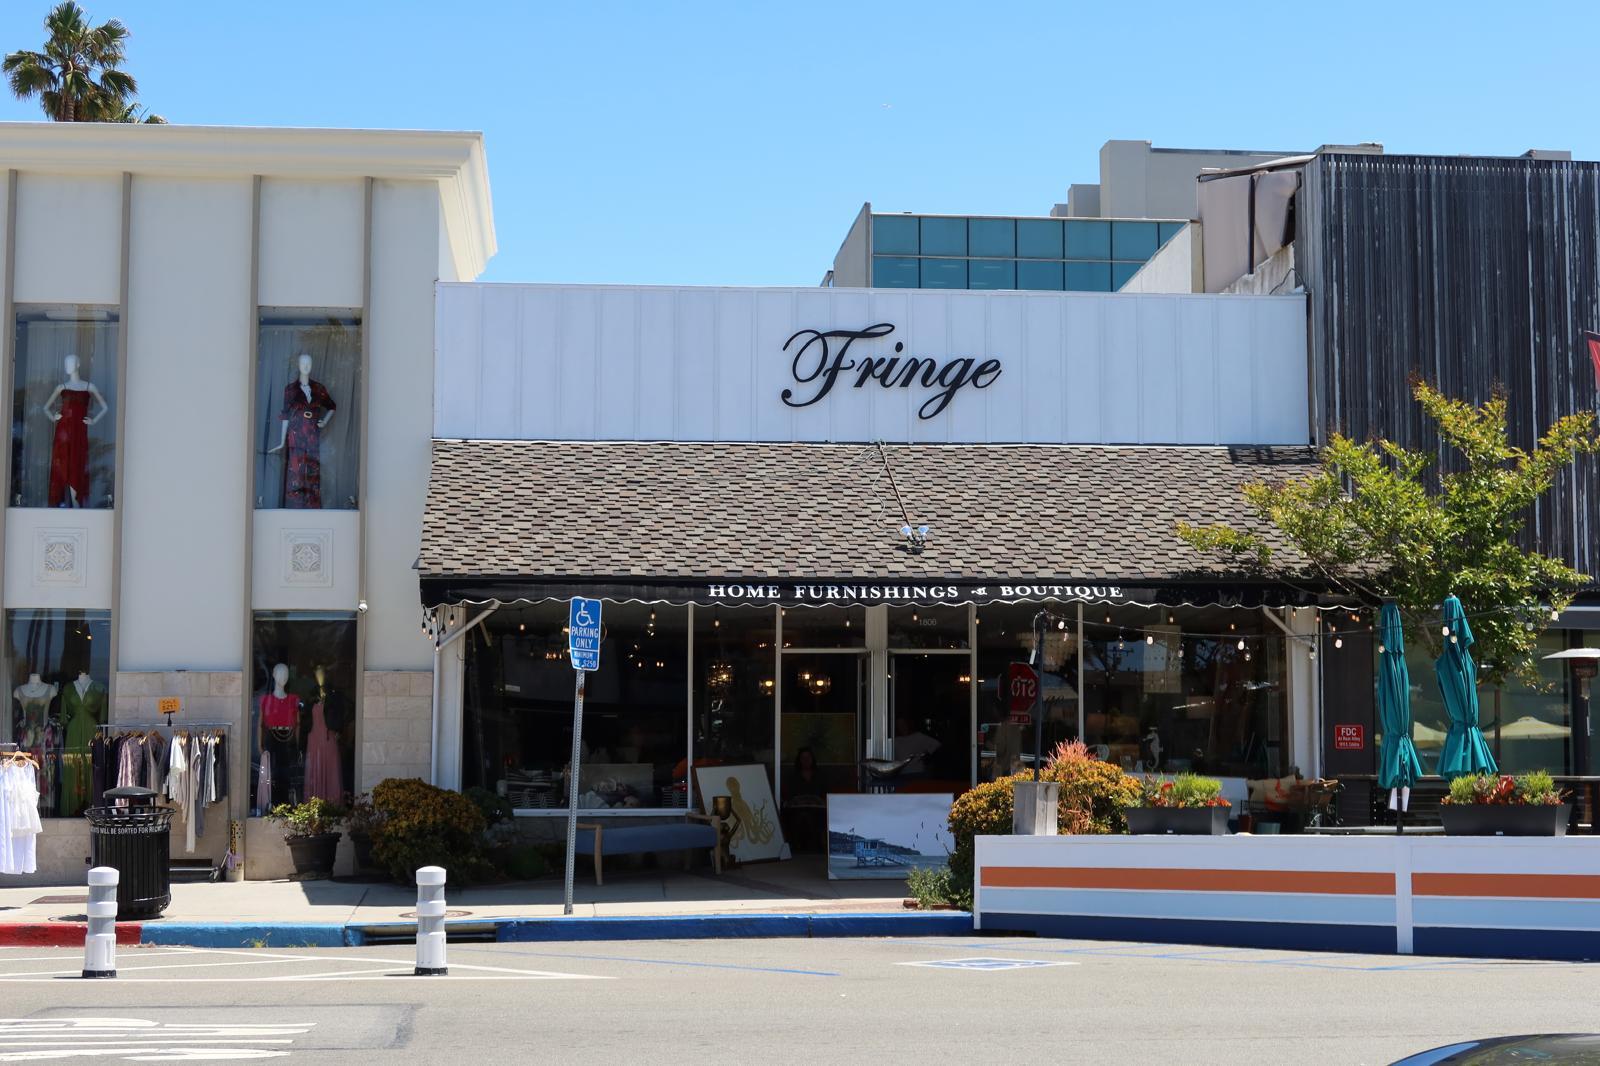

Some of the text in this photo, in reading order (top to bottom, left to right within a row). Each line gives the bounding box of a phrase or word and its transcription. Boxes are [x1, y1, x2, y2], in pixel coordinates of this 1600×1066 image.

[781, 322, 1002, 420] Fringe
[708, 584, 781, 598] HOME
[794, 585, 959, 599] FURNISHINGS
[1001, 585, 1124, 600] BOUTIQUE
[571, 626, 599, 639] PARKING
[575, 638, 593, 648] ONLY
[1341, 727, 1357, 736] FDC
[110, 827, 117, 835] BE
[117, 827, 138, 835] SORTED
[138, 826, 149, 834] FOR
